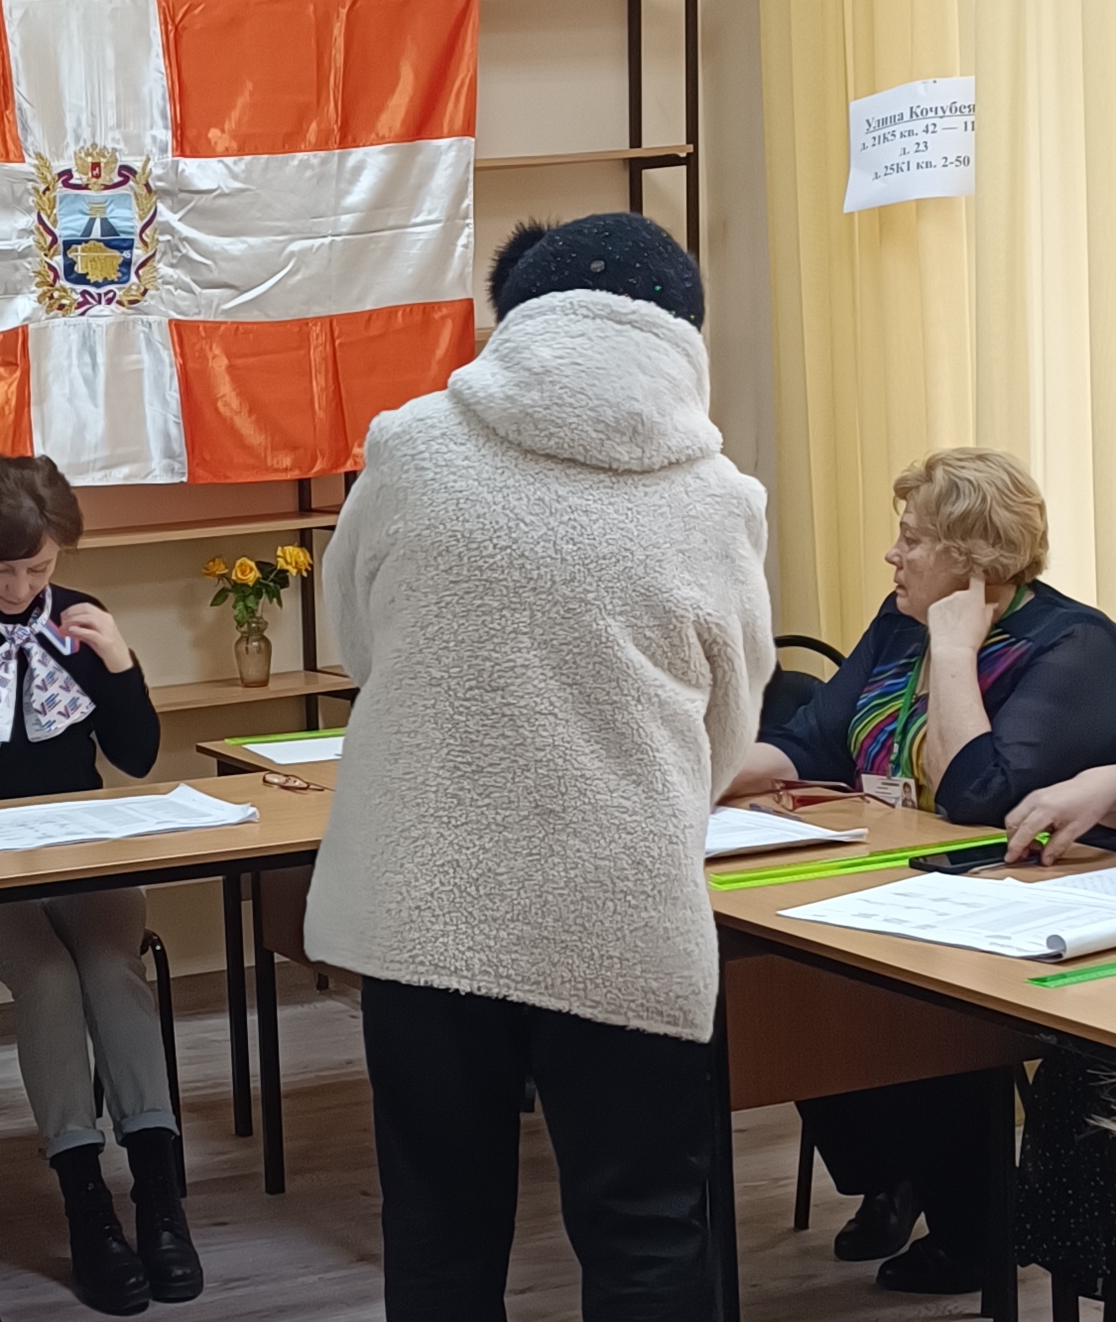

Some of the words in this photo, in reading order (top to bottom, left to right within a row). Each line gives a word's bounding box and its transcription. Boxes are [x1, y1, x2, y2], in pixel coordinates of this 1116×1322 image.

[865, 112, 904, 131] Улица
[909, 101, 975, 118] Кочубея
[871, 130, 897, 148] 21К5
[899, 129, 918, 140] кв.
[922, 123, 938, 135] 42
[899, 147, 910, 157] д.
[914, 141, 929, 153] 23
[883, 160, 911, 177] 25К1
[916, 160, 937, 171] кв.
[941, 155, 971, 168] 2-50
